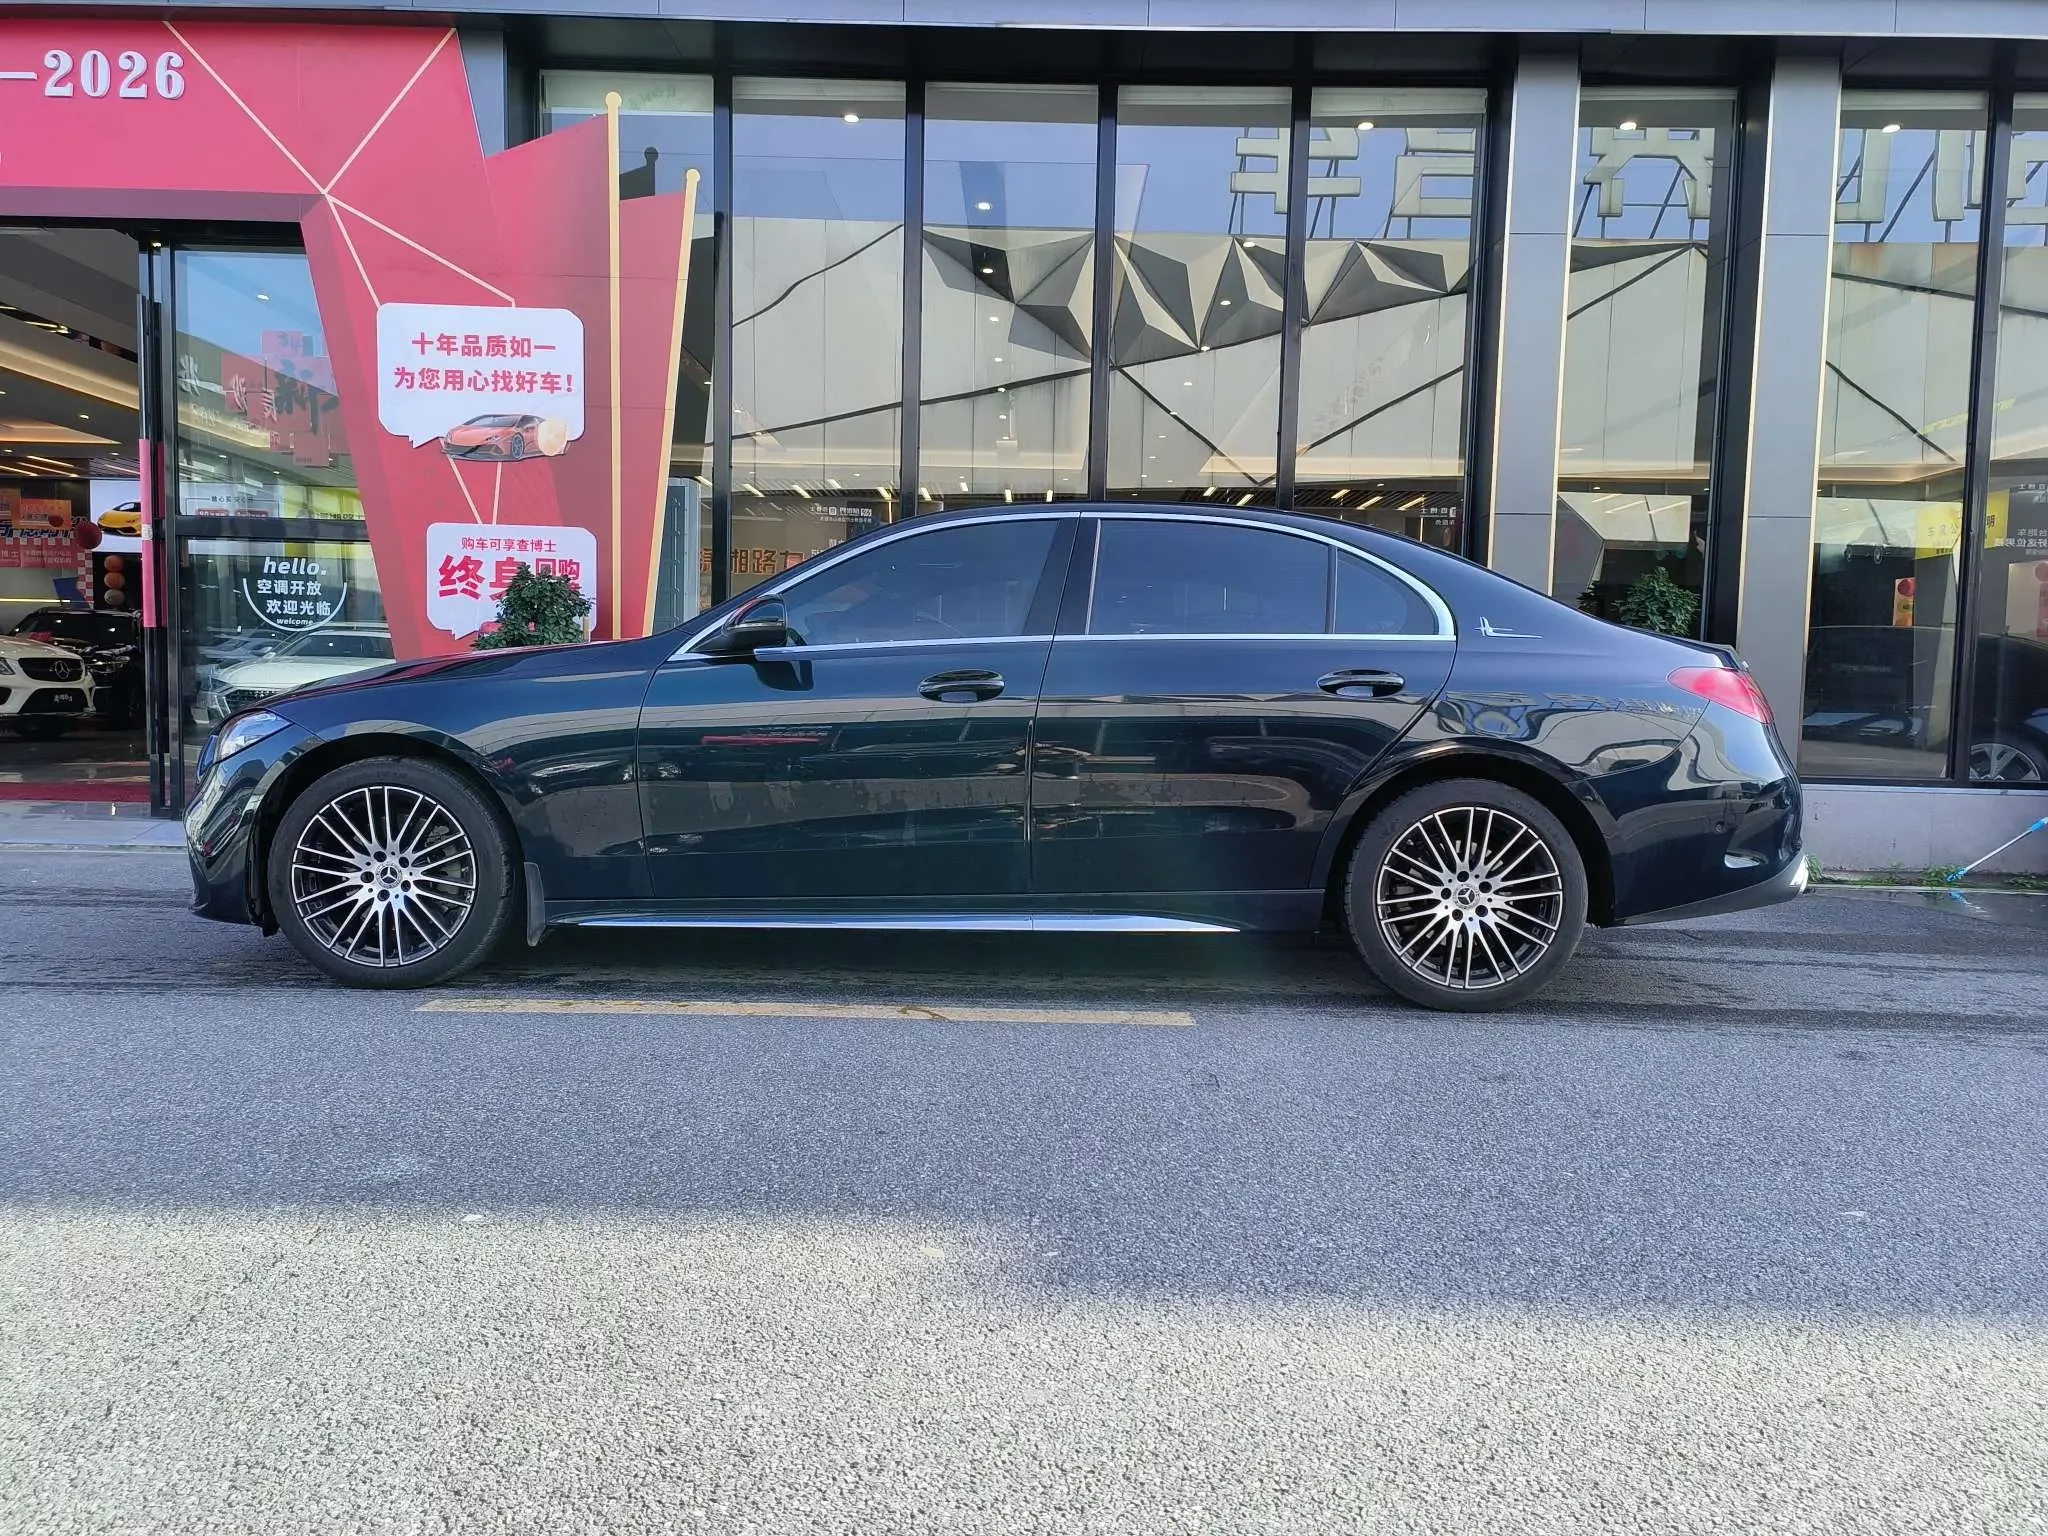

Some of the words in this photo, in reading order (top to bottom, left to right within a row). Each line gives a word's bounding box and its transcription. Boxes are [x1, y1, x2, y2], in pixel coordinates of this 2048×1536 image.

[411, 331, 557, 358] 十年品质如一
[393, 366, 575, 394] 为您用心找好车!
[461, 537, 557, 553] 购车可享查博士
[263, 556, 327, 576] hello.
[257, 578, 322, 596] 空调开放
[266, 599, 332, 616] 欢迎光临
